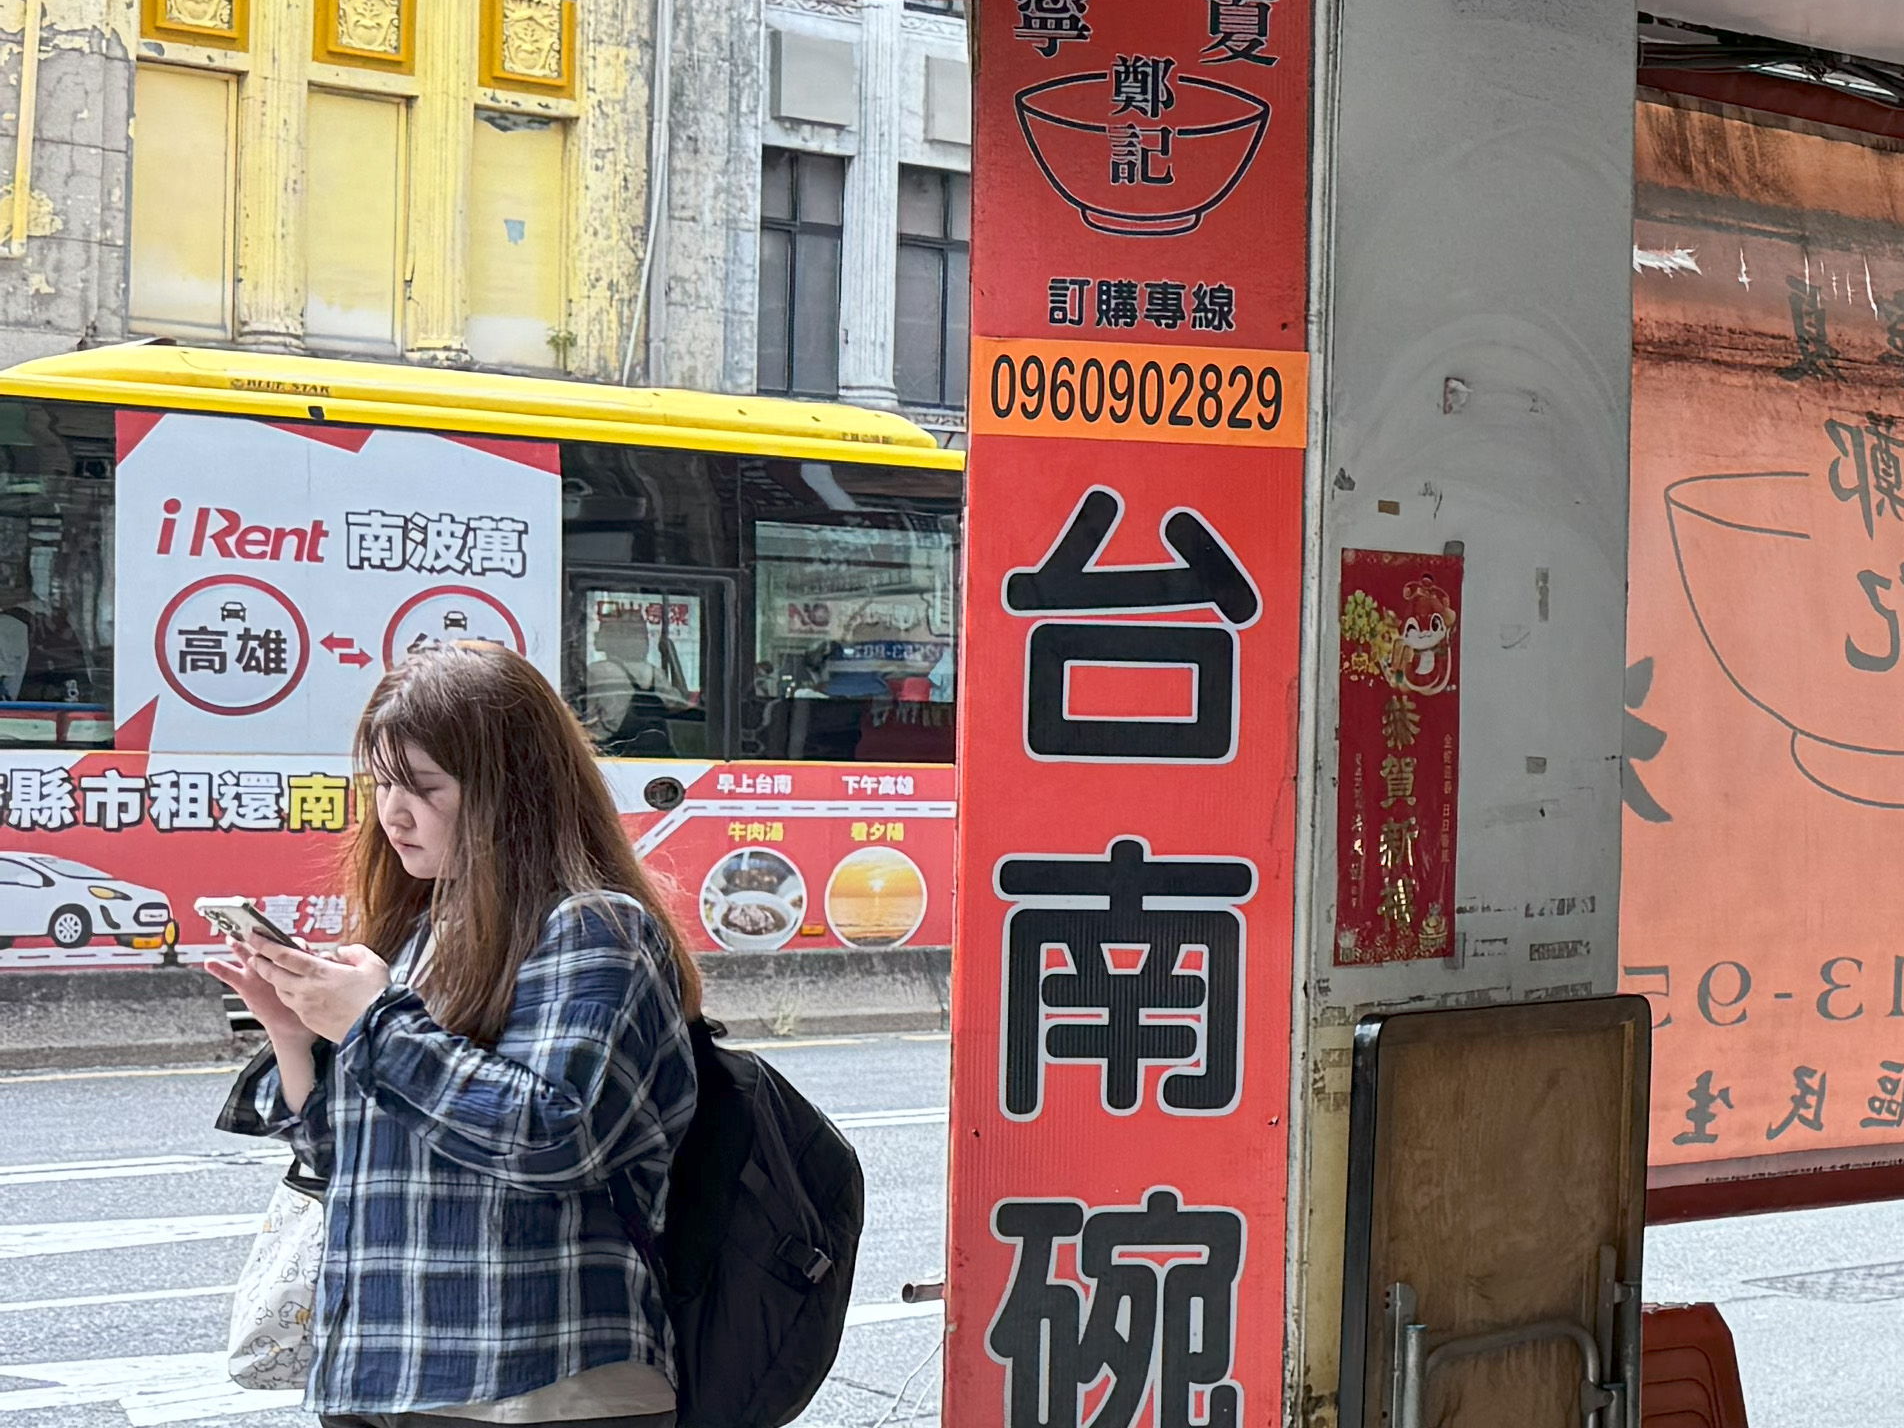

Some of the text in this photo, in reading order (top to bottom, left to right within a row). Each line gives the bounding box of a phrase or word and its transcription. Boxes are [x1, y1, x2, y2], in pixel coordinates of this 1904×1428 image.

[1106, 55, 1176, 185] 鄭記
[1047, 277, 1237, 332] 訂購專線
[989, 353, 1283, 431] 0960902829
[345, 509, 529, 579] 南波萬
[177, 625, 288, 676] 高雄
[0, 766, 374, 832] 縣市租還南
[717, 773, 792, 795] 早上台南
[841, 775, 915, 796] 下午高雄
[727, 821, 784, 842] 牛肉湯
[850, 821, 905, 842] 看夕陽
